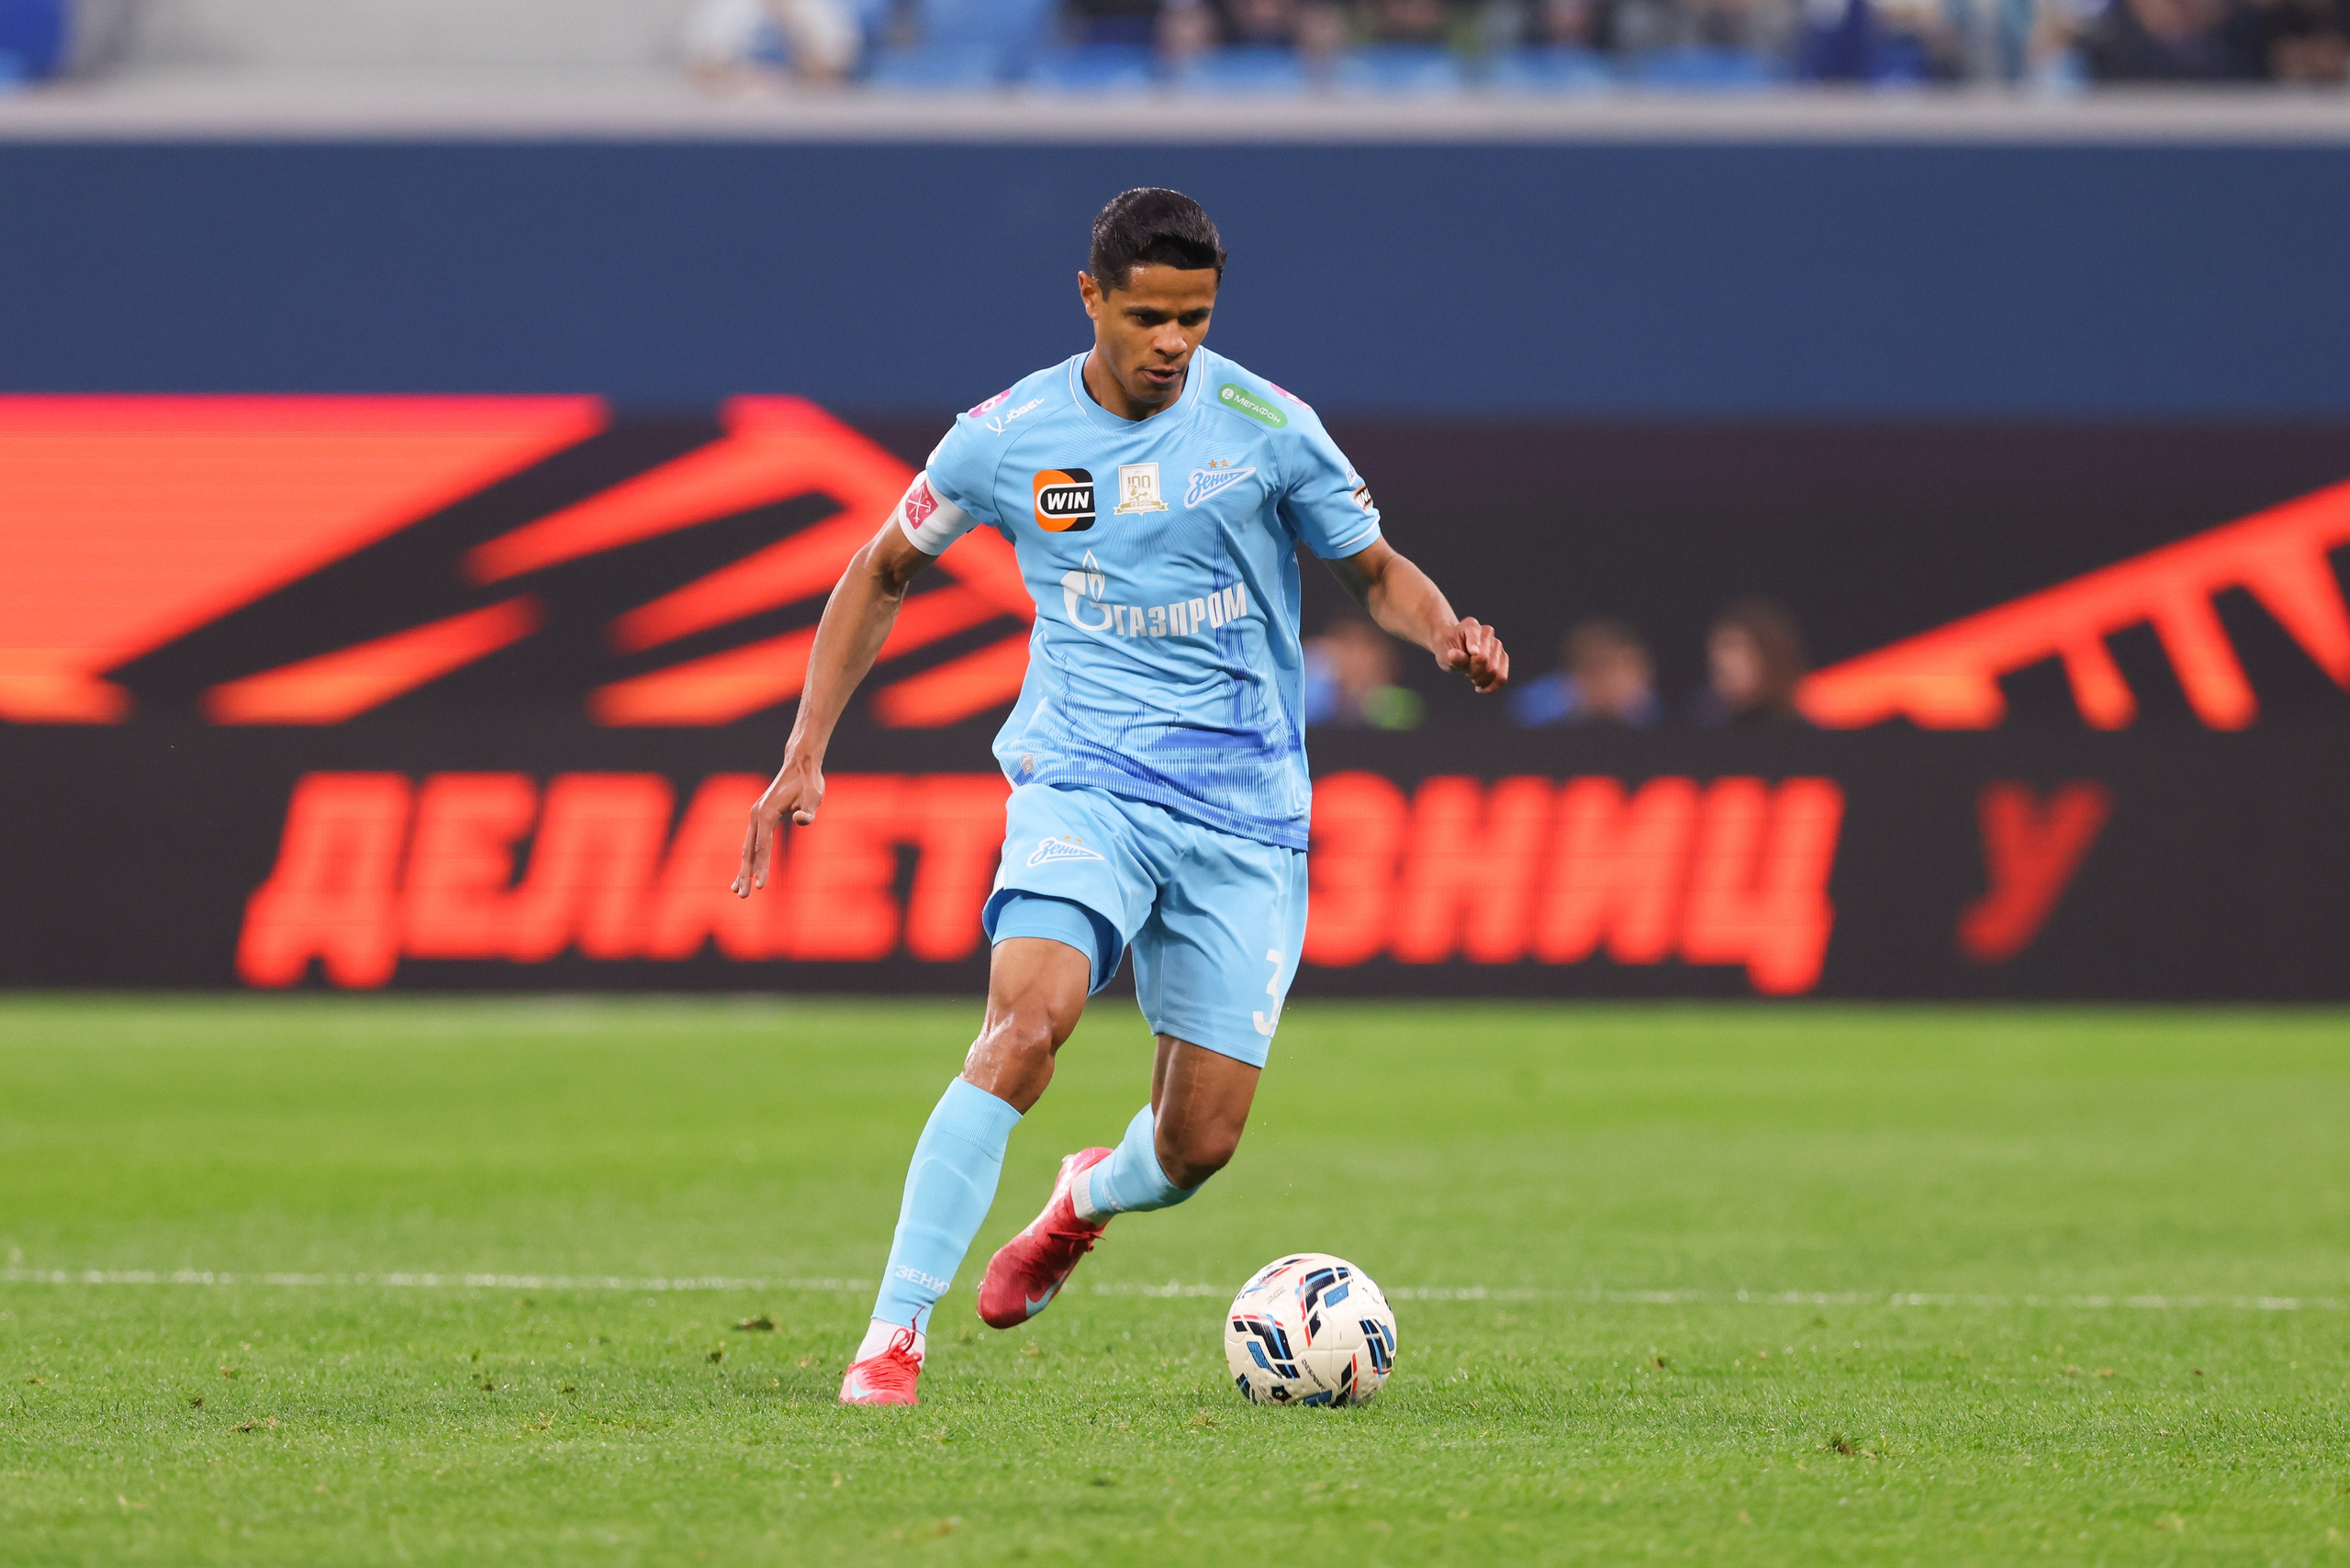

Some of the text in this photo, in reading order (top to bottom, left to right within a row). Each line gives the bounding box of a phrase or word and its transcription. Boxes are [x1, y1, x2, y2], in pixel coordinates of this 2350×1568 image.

[1004, 398, 1046, 425] JÖGEL
[1233, 393, 1281, 424] МЕГАФОН
[1046, 491, 1090, 510] WIN
[1113, 582, 1248, 638] ГАЗПРОМ
[235, 771, 1010, 989] ДЕЛАЕТ
